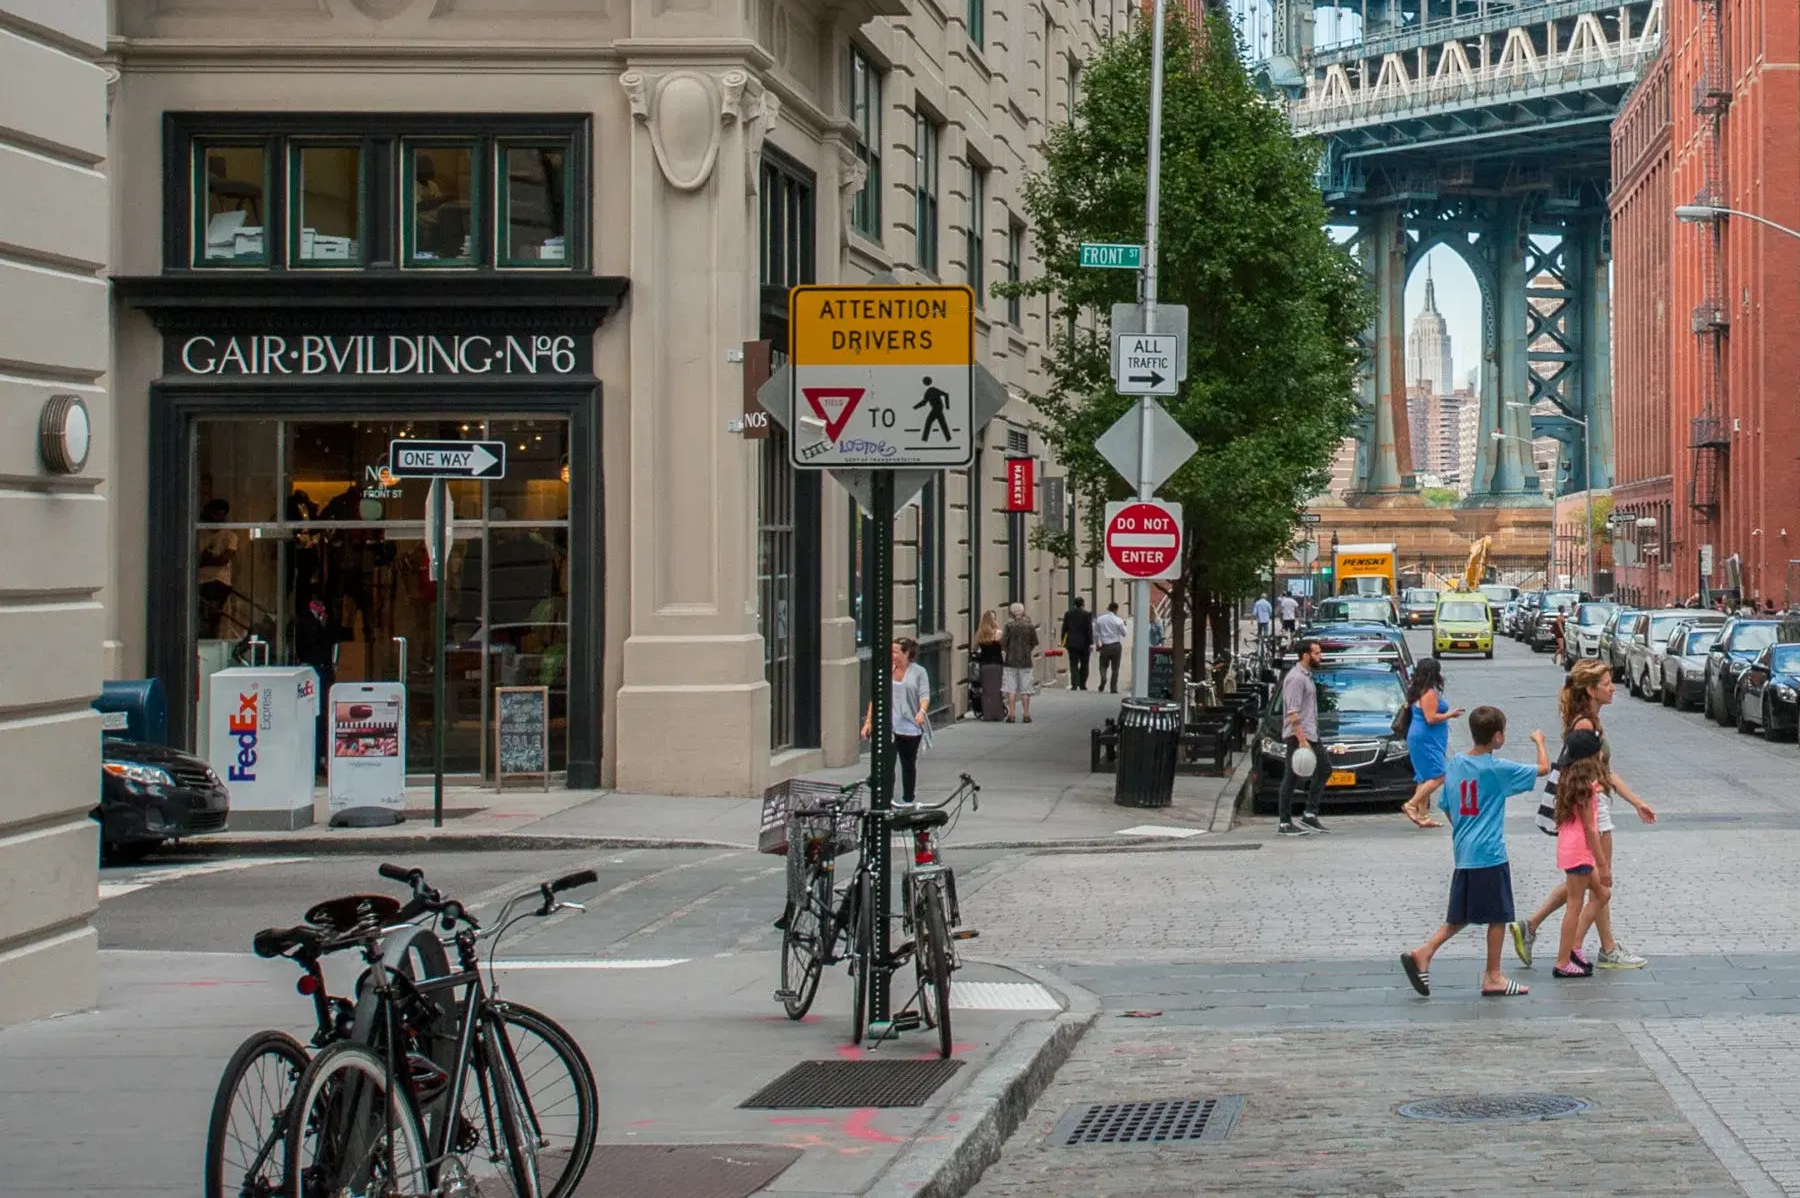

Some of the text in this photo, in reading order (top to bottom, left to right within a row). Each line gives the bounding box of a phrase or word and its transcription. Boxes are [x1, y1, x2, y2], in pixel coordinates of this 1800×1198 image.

[1083, 247, 1138, 264] FRONT ST
[819, 299, 947, 319] ATTENTION
[831, 330, 933, 350] DRIVERS
[1133, 339, 1162, 354] ALL
[1128, 357, 1168, 369] TRAFFIC
[744, 411, 768, 428] NOS
[867, 406, 896, 428] TO
[404, 452, 472, 467] ONE WAY
[363, 489, 402, 499] FRONT ST
[1014, 465, 1022, 506] MARKET
[1117, 517, 1169, 530] DO NOT
[1121, 550, 1164, 563] ENTER
[1342, 557, 1388, 566] PENSKE
[260, 688, 273, 731] Express
[228, 692, 258, 782] FedEx
[1459, 778, 1480, 817] 11
